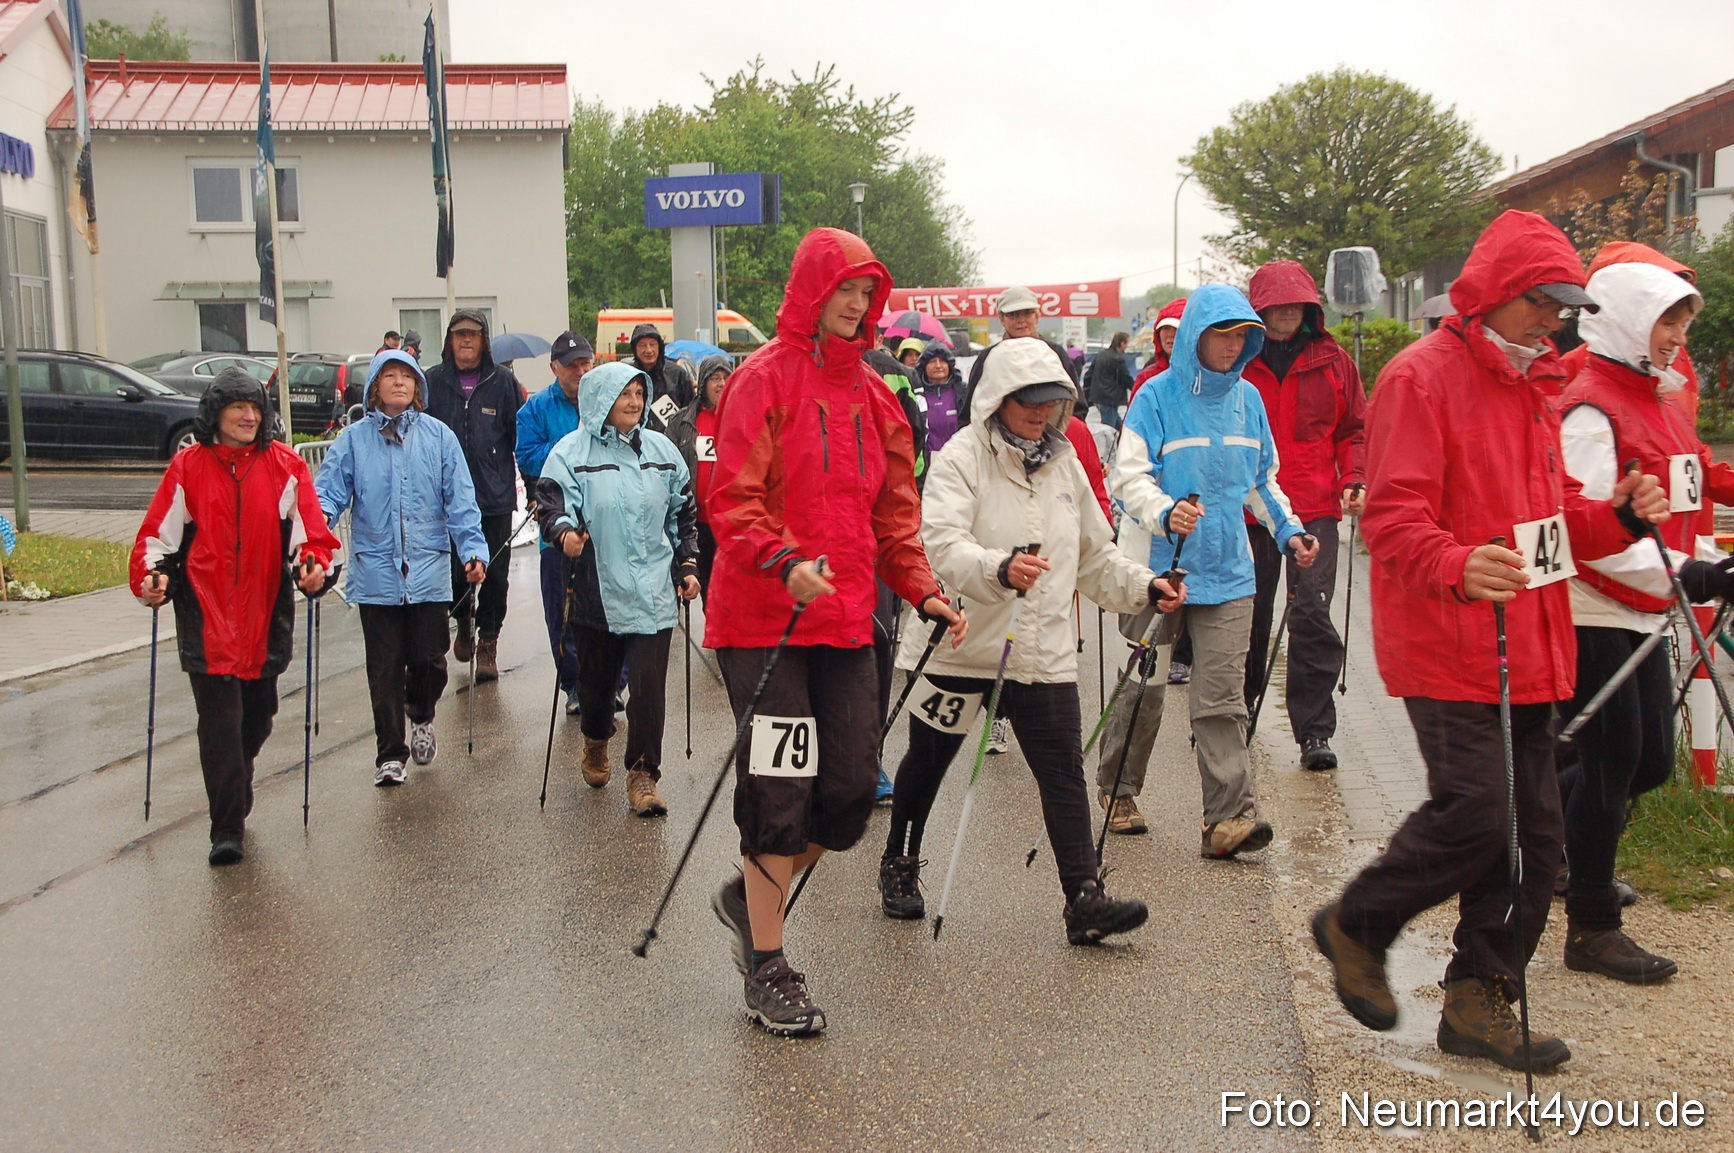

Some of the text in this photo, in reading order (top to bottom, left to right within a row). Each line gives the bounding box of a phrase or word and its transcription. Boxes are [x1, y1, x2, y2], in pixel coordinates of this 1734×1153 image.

[655, 189, 746, 211] VOLVO
[1535, 520, 1562, 575] 42
[920, 691, 966, 728] 43
[771, 721, 810, 770] 79
